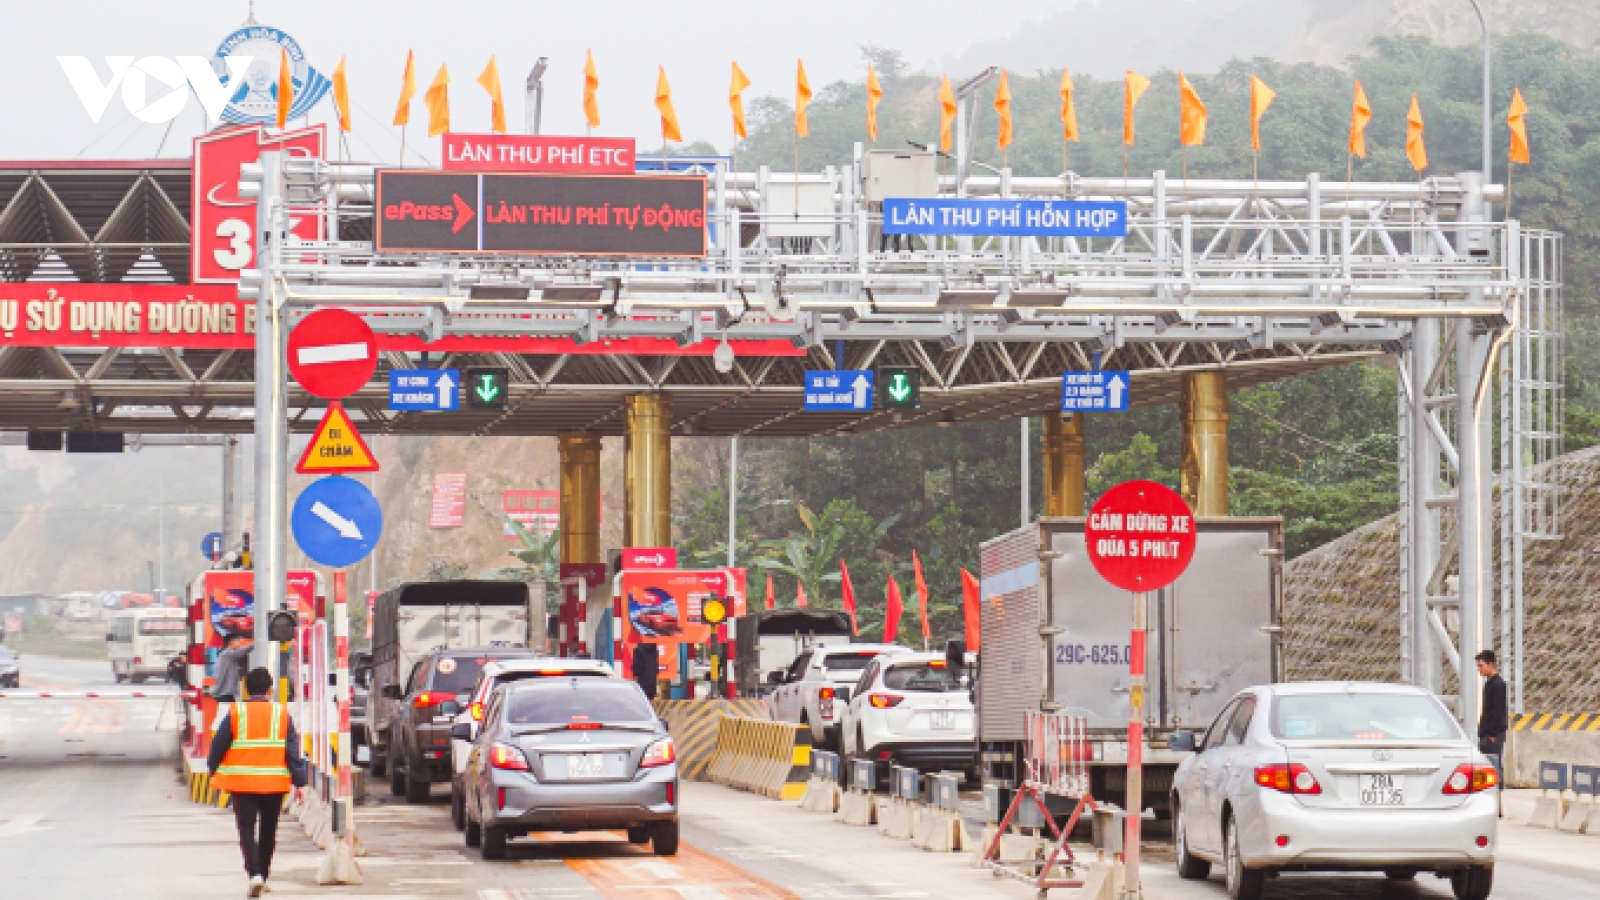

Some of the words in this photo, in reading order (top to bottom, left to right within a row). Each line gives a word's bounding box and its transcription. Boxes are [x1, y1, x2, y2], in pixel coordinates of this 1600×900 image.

[448, 142, 492, 164] LÀN
[497, 144, 541, 164] THU
[548, 143, 584, 165] PHÍ
[589, 148, 629, 166] ETC
[385, 200, 453, 221] ePass
[486, 199, 526, 224] LÀN
[530, 205, 571, 225] THU
[576, 202, 608, 225] PHÍ
[614, 202, 641, 231] TỰ
[642, 203, 704, 232] ĐỘNG
[891, 202, 935, 225] LÀN
[939, 206, 982, 225] THU
[986, 202, 1022, 227] PHÍ
[1025, 202, 1069, 228] HỖN
[1074, 208, 1119, 232] HỢP
[26, 288, 66, 332] SỬ
[70, 301, 142, 340] DỤNG
[148, 294, 237, 334] ĐƯỜNG
[1090, 506, 1123, 532] CẤM
[1126, 508, 1168, 533] DỪNG
[1171, 515, 1189, 534] XE
[1128, 538, 1140, 557] 5
[1055, 644, 1132, 665] 29C-625.0
